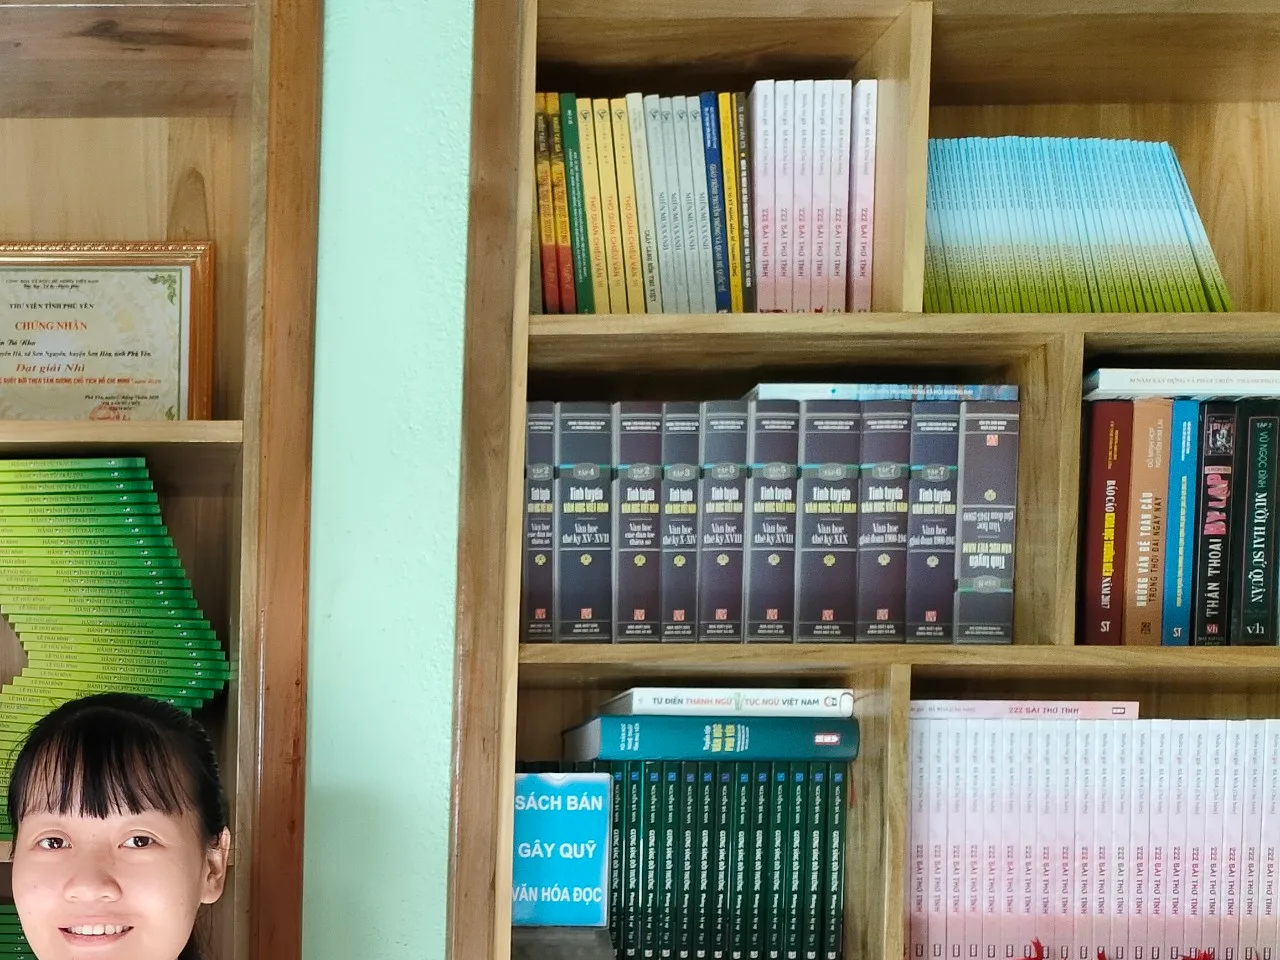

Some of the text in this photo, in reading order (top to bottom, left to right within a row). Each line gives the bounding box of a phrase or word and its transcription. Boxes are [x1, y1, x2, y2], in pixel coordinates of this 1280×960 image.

[15, 320, 88, 331] CHỨNG NHẬN
[1254, 492, 1269, 523] MƯỜI
[1252, 527, 1266, 548] HAI
[1207, 538, 1222, 577] THOẠI
[1252, 551, 1267, 567] SỨ
[1249, 569, 1265, 602] QUÂN
[1247, 622, 1265, 635] vh
[782, 697, 799, 706] VIỆT
[801, 698, 819, 706] NAM
[515, 792, 602, 811] SÁCH BÁN
[518, 839, 597, 859] GÂY QUỸ
[512, 883, 602, 905] VĂN HÓA ĐỌC
